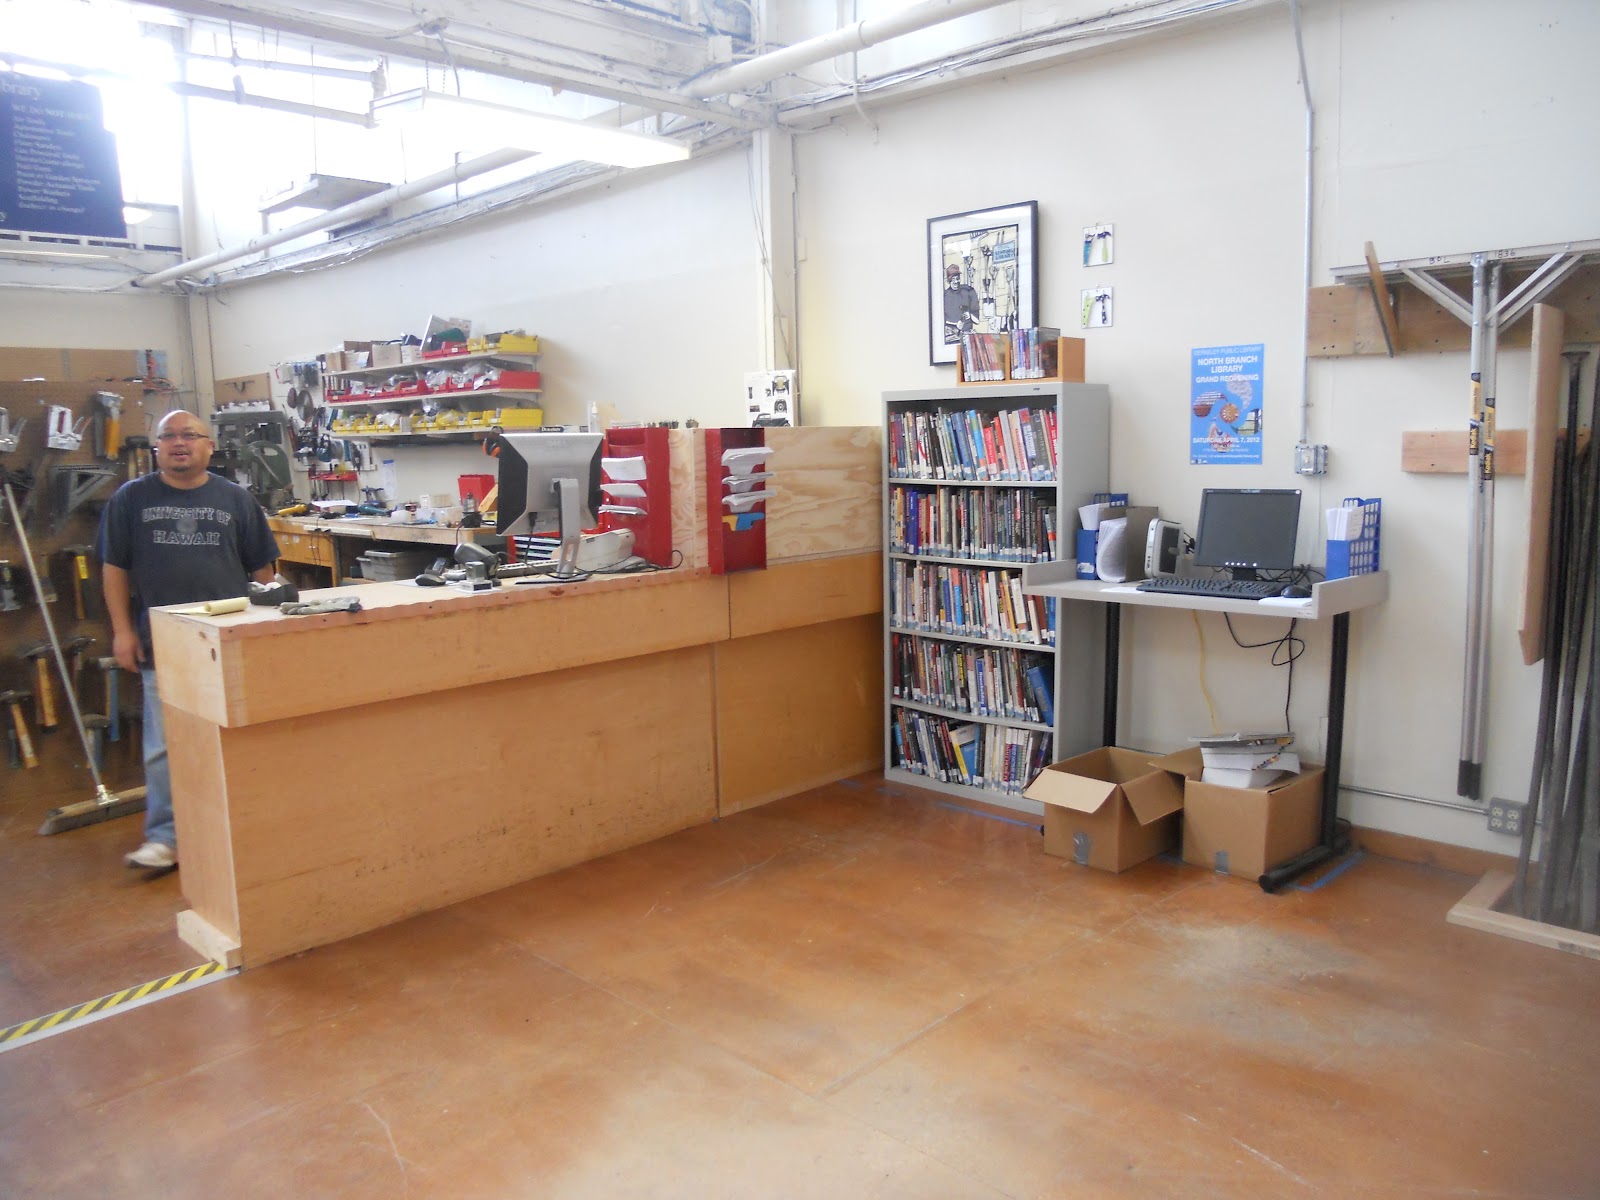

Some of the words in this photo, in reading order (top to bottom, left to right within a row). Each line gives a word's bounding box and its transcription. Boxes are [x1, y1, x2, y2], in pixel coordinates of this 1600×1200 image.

[1197, 358, 1224, 366] NORTH
[1225, 355, 1258, 364] BRANCH
[1211, 365, 1243, 373] LIBRARY
[1220, 374, 1259, 382] REOPENING
[142, 506, 216, 523] UNIVERSITY
[217, 509, 231, 526] OF
[153, 530, 220, 546] HAWAII
